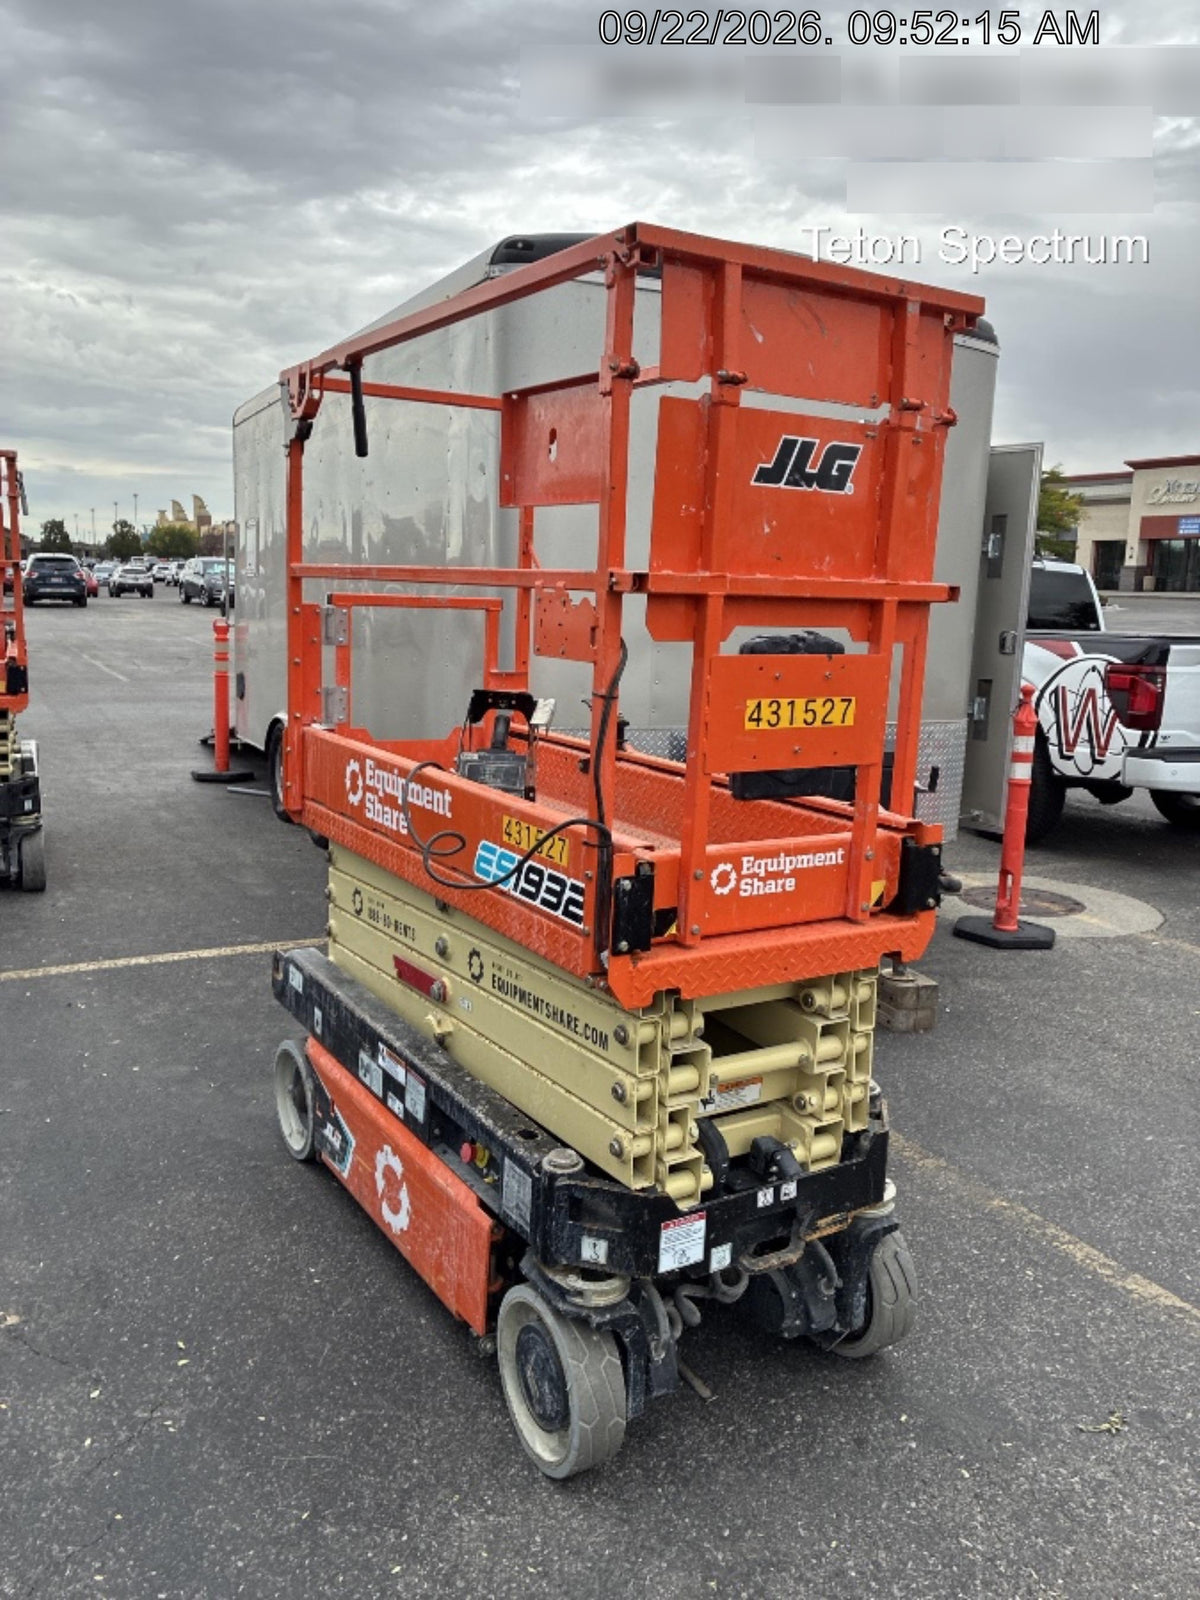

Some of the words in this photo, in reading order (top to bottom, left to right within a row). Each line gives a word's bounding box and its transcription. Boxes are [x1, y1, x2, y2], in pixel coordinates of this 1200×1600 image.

[750, 434, 863, 494] JLG
[747, 698, 853, 728] 431527
[365, 758, 453, 819] Equipment
[365, 786, 409, 836] Share
[739, 877, 796, 897] Share
[741, 847, 845, 877] Equipment
[491, 973, 609, 1052] EQUIPMENTSHARE.COM
